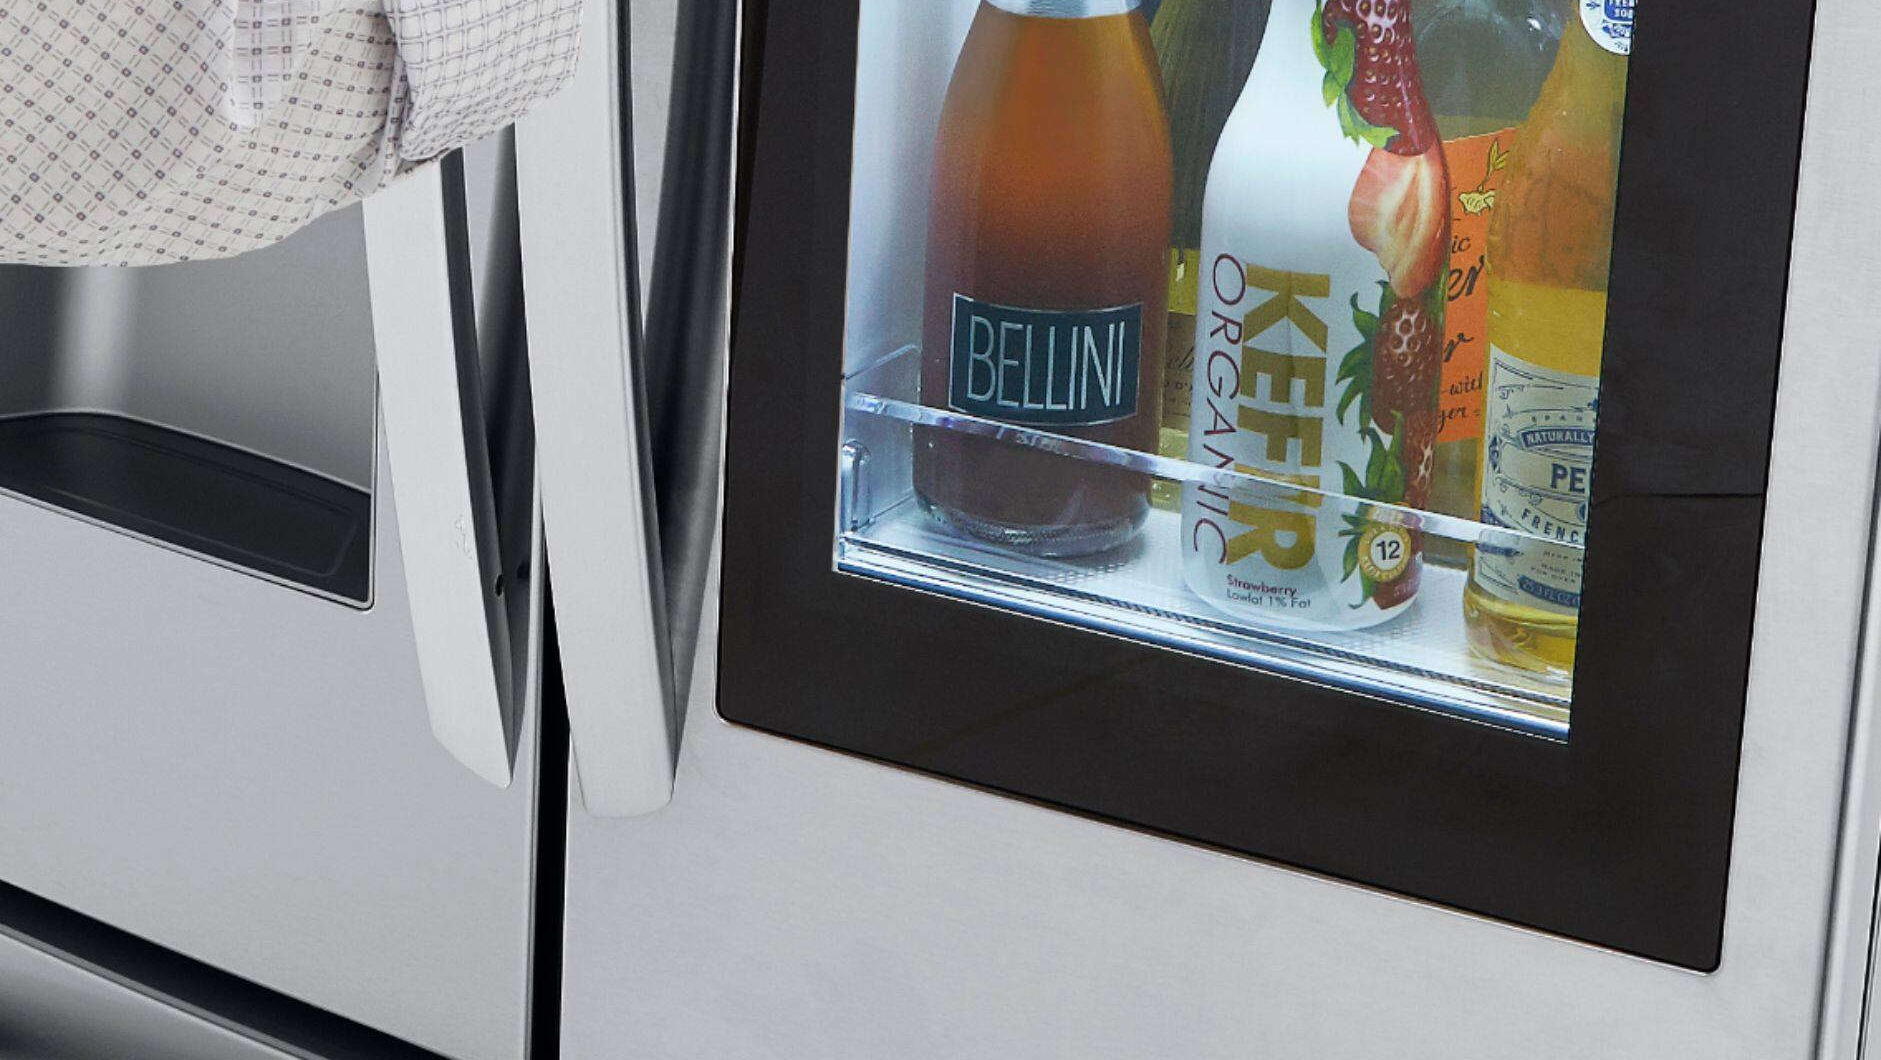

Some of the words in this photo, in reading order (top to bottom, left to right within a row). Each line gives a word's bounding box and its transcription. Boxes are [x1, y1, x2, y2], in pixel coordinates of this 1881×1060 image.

[966, 314, 1126, 411] BELLINI
[1193, 252, 1246, 565] ORGANIC
[1226, 262, 1331, 572] KEFIR
[1525, 430, 1596, 445] NATURALLY
[1376, 539, 1401, 561] 12
[1226, 573, 1299, 597] Strawberry
[1226, 587, 1264, 606] Lowfat
[1269, 595, 1288, 608] 1%
[1290, 597, 1311, 609] Fat
